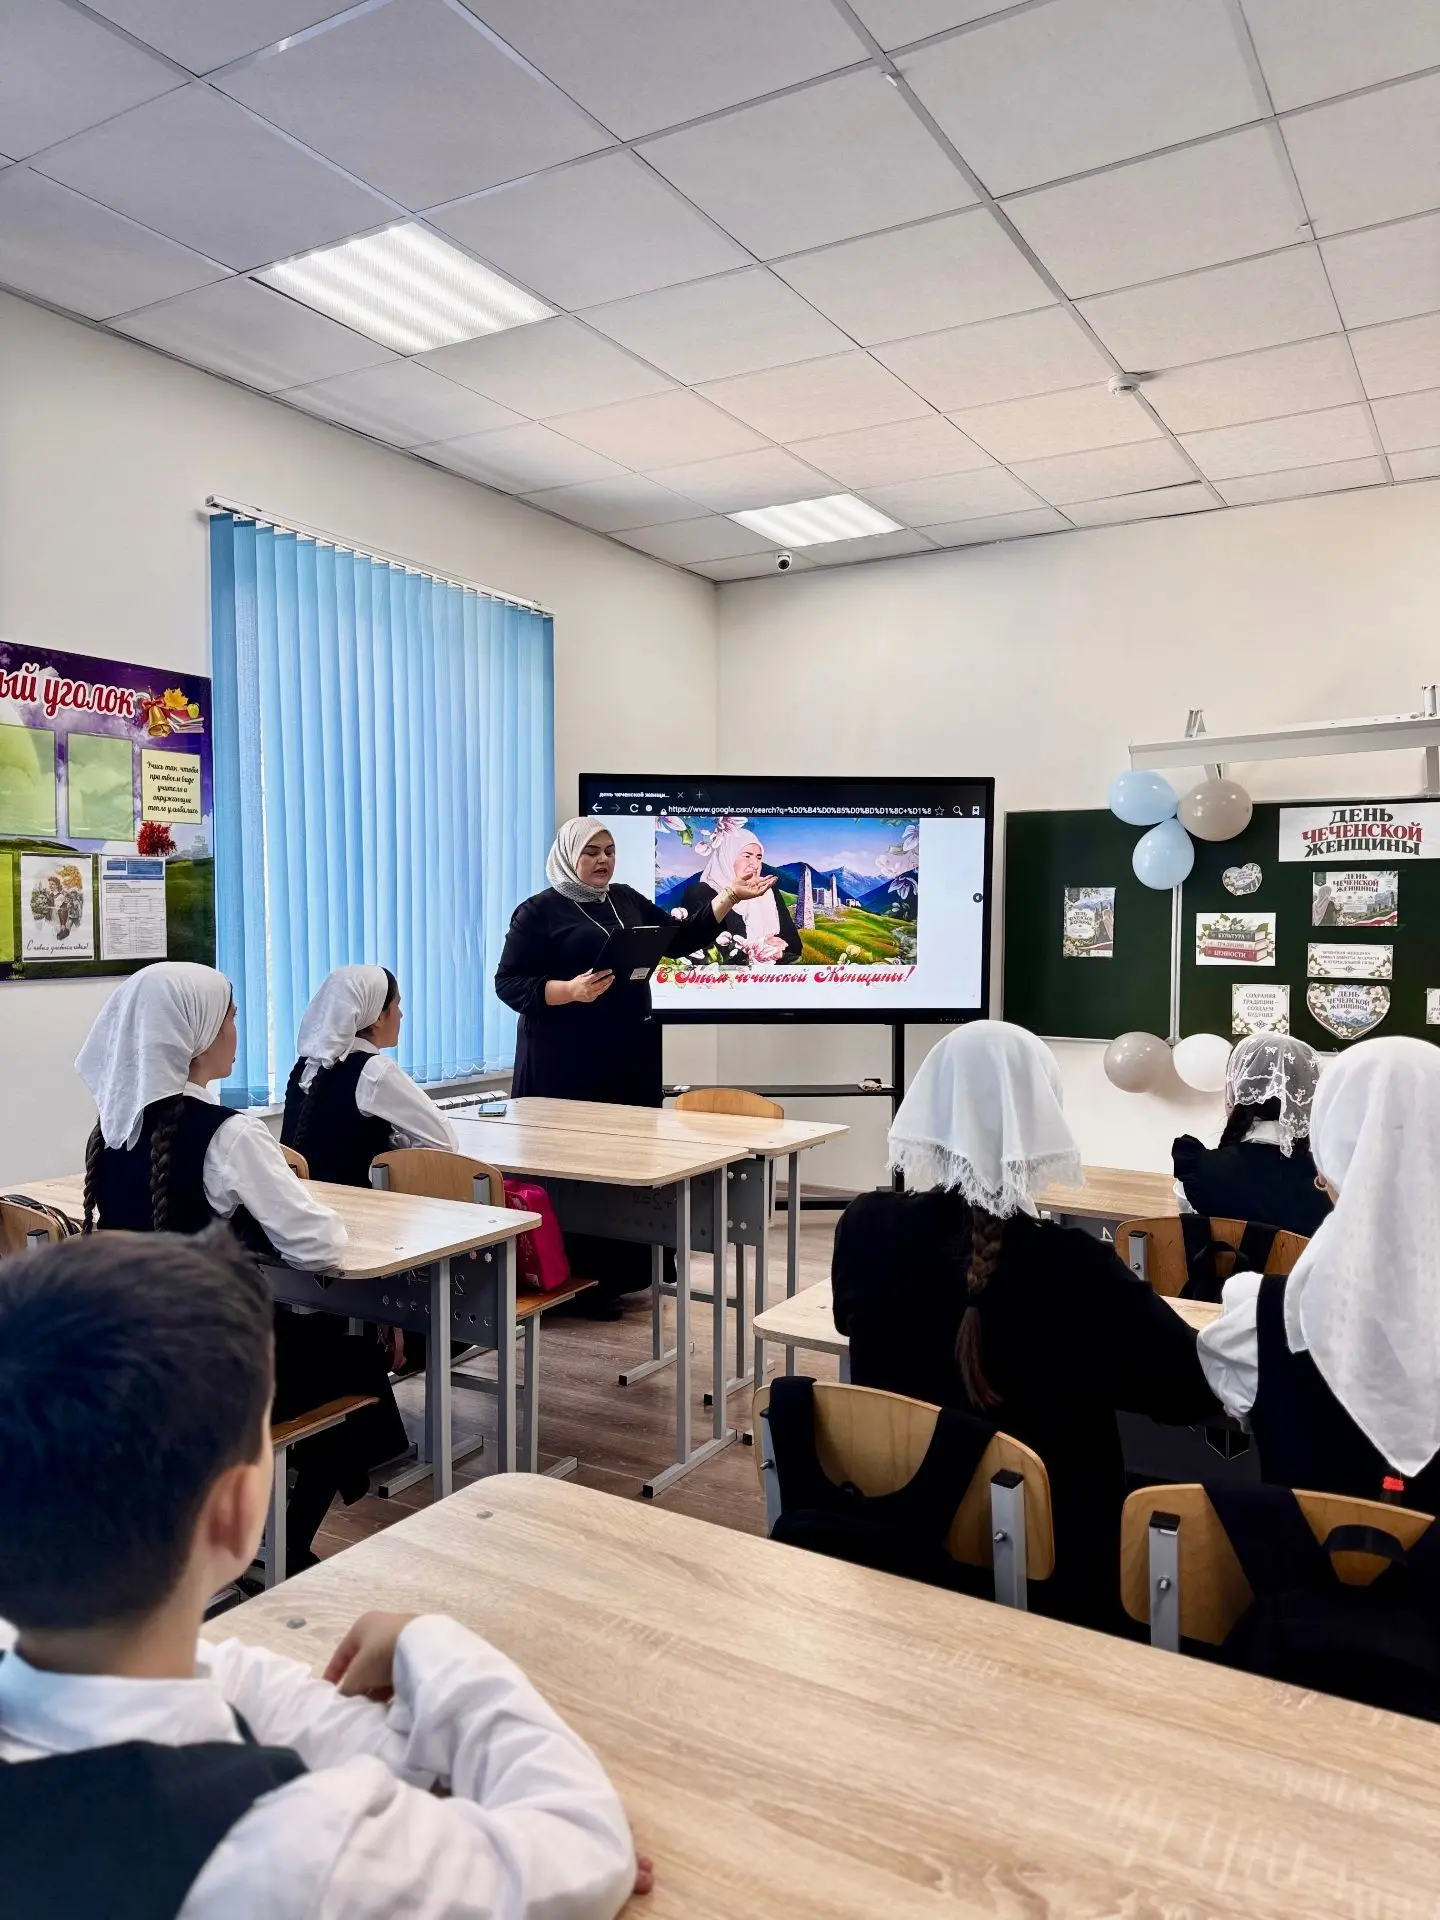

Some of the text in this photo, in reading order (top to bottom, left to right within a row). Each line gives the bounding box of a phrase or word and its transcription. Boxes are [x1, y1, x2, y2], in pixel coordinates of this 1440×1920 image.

[44, 678, 135, 716] уголок
[180, 766, 199, 774] чтобы
[150, 774, 160, 782] при
[182, 776, 194, 786] виде
[153, 795, 192, 804] окружающие
[168, 806, 199, 814] улыбались
[1330, 808, 1394, 825] ДЕНЬ
[1302, 822, 1422, 843] ЧЕЧЕНСКОЙ
[1304, 838, 1420, 858] ЖЕНЩИНЫ
[1333, 879, 1379, 887] ЧЕЧЕНСКОЙ
[1214, 950, 1246, 958] ЦЕННОСТИ
[814, 966, 916, 986] Женщины!
[1327, 997, 1370, 1007] ЧЕЧЕНСКОЙ
